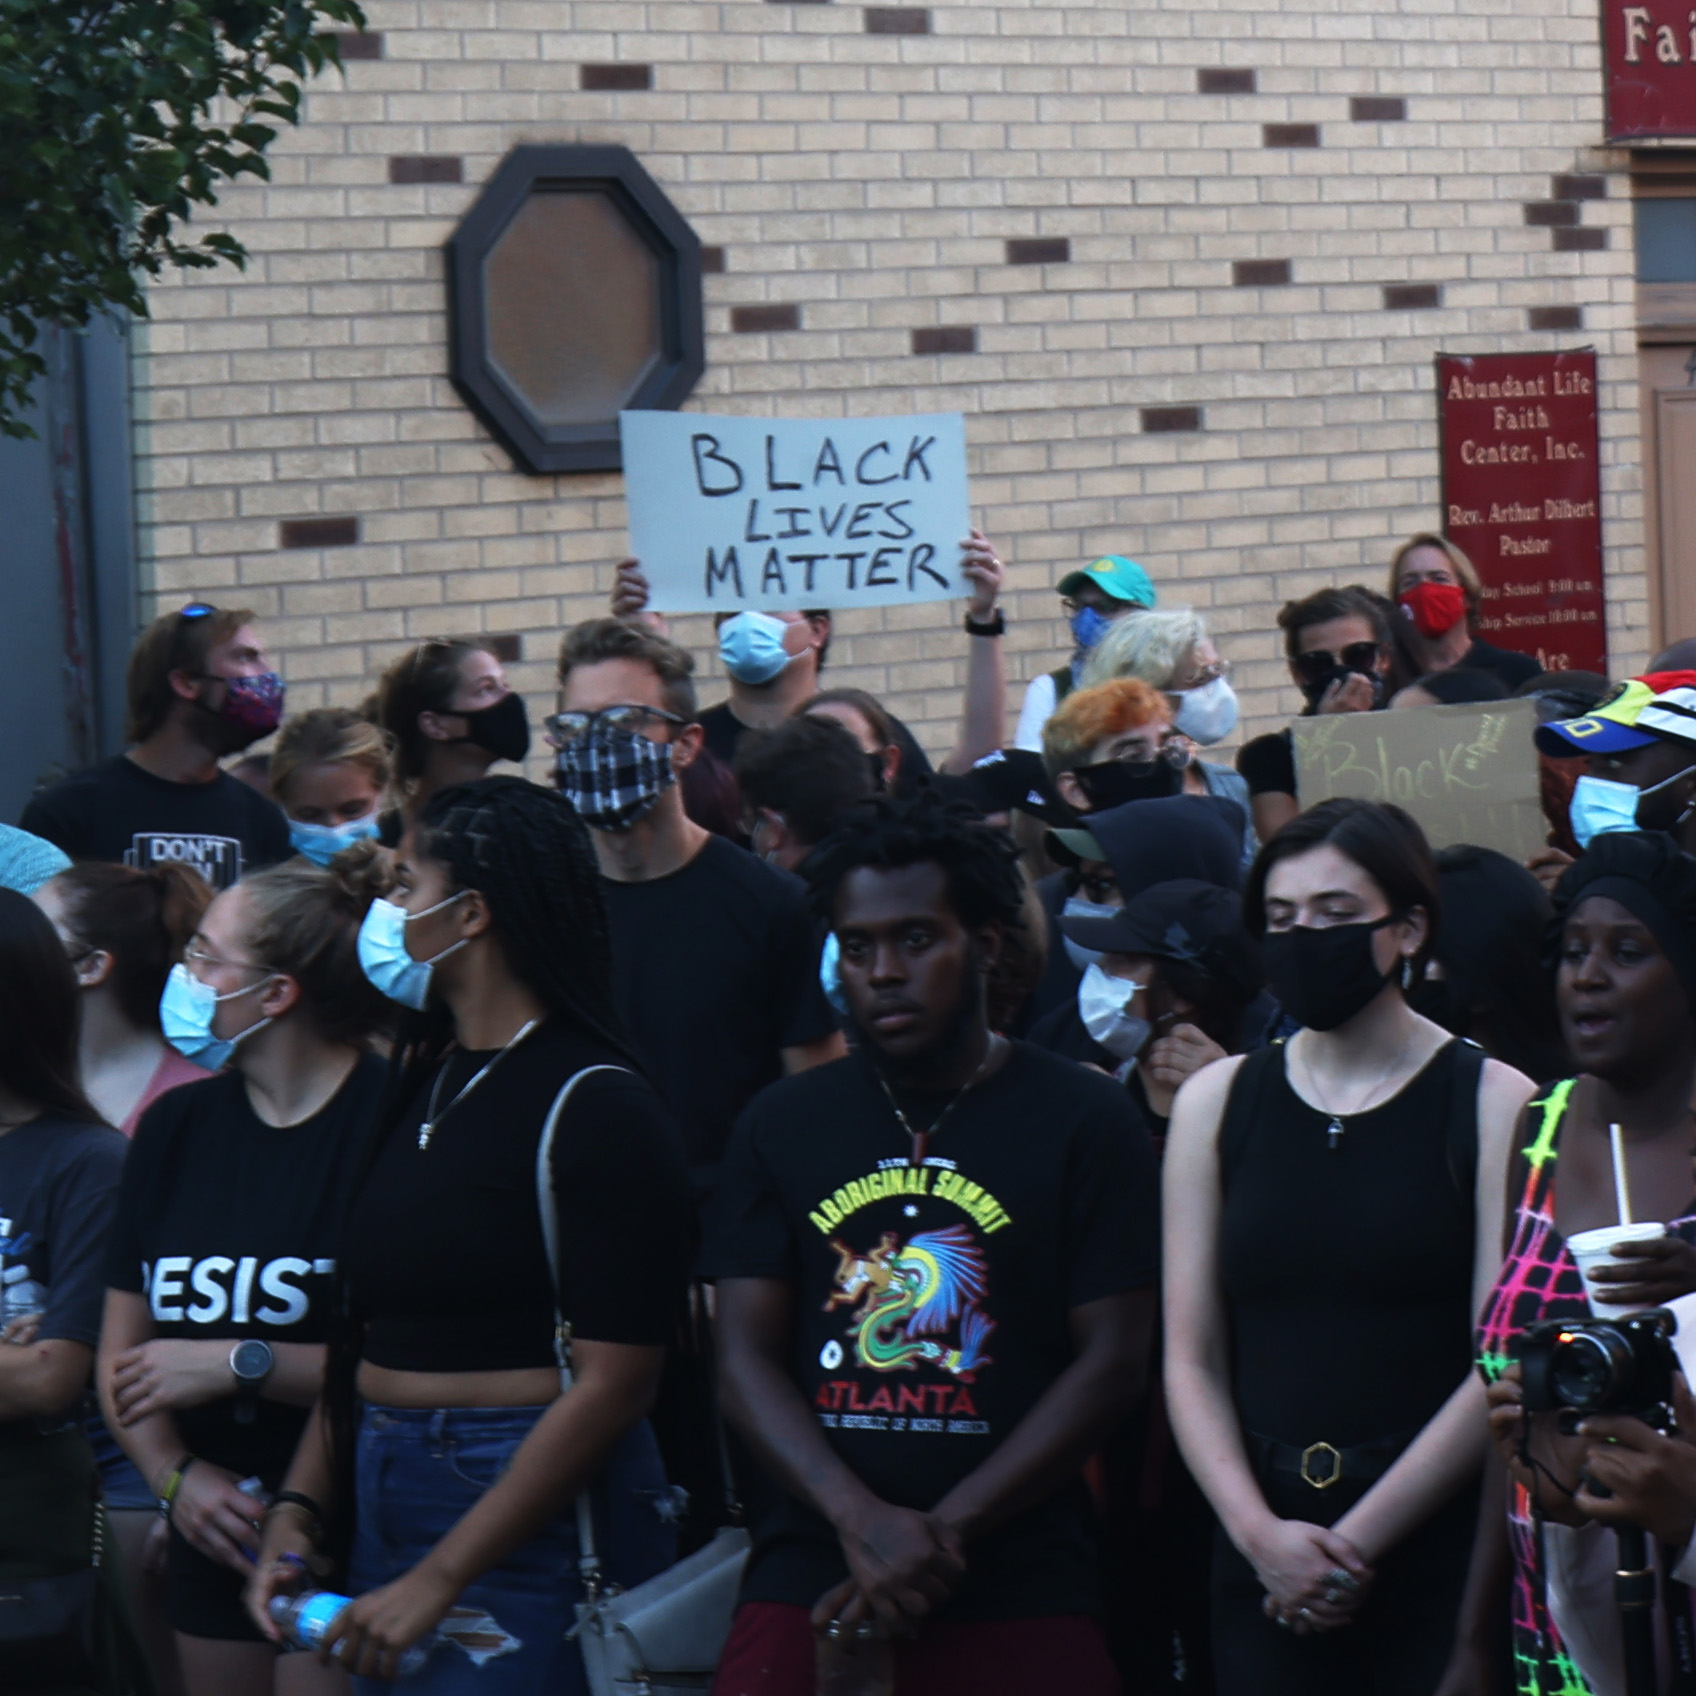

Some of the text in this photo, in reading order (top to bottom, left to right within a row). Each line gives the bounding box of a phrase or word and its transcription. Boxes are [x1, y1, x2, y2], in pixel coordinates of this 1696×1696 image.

[1447, 370, 1594, 400] Abundant Life
[1493, 404, 1550, 431] Faith
[691, 432, 937, 497] BLACK
[1459, 435, 1586, 465] Center, Inc.
[744, 498, 916, 543] LIVES
[1448, 504, 1485, 526] Rev.
[1488, 501, 1541, 524] Arthur
[1499, 535, 1551, 556] Pastor
[703, 543, 950, 599] MATTER
[151, 838, 226, 863] DON'T
[808, 1167, 1012, 1235] ABORIGINAL SUMMIT
[142, 1255, 337, 1326] ESIS
[816, 1380, 979, 1417] ATLANTA
